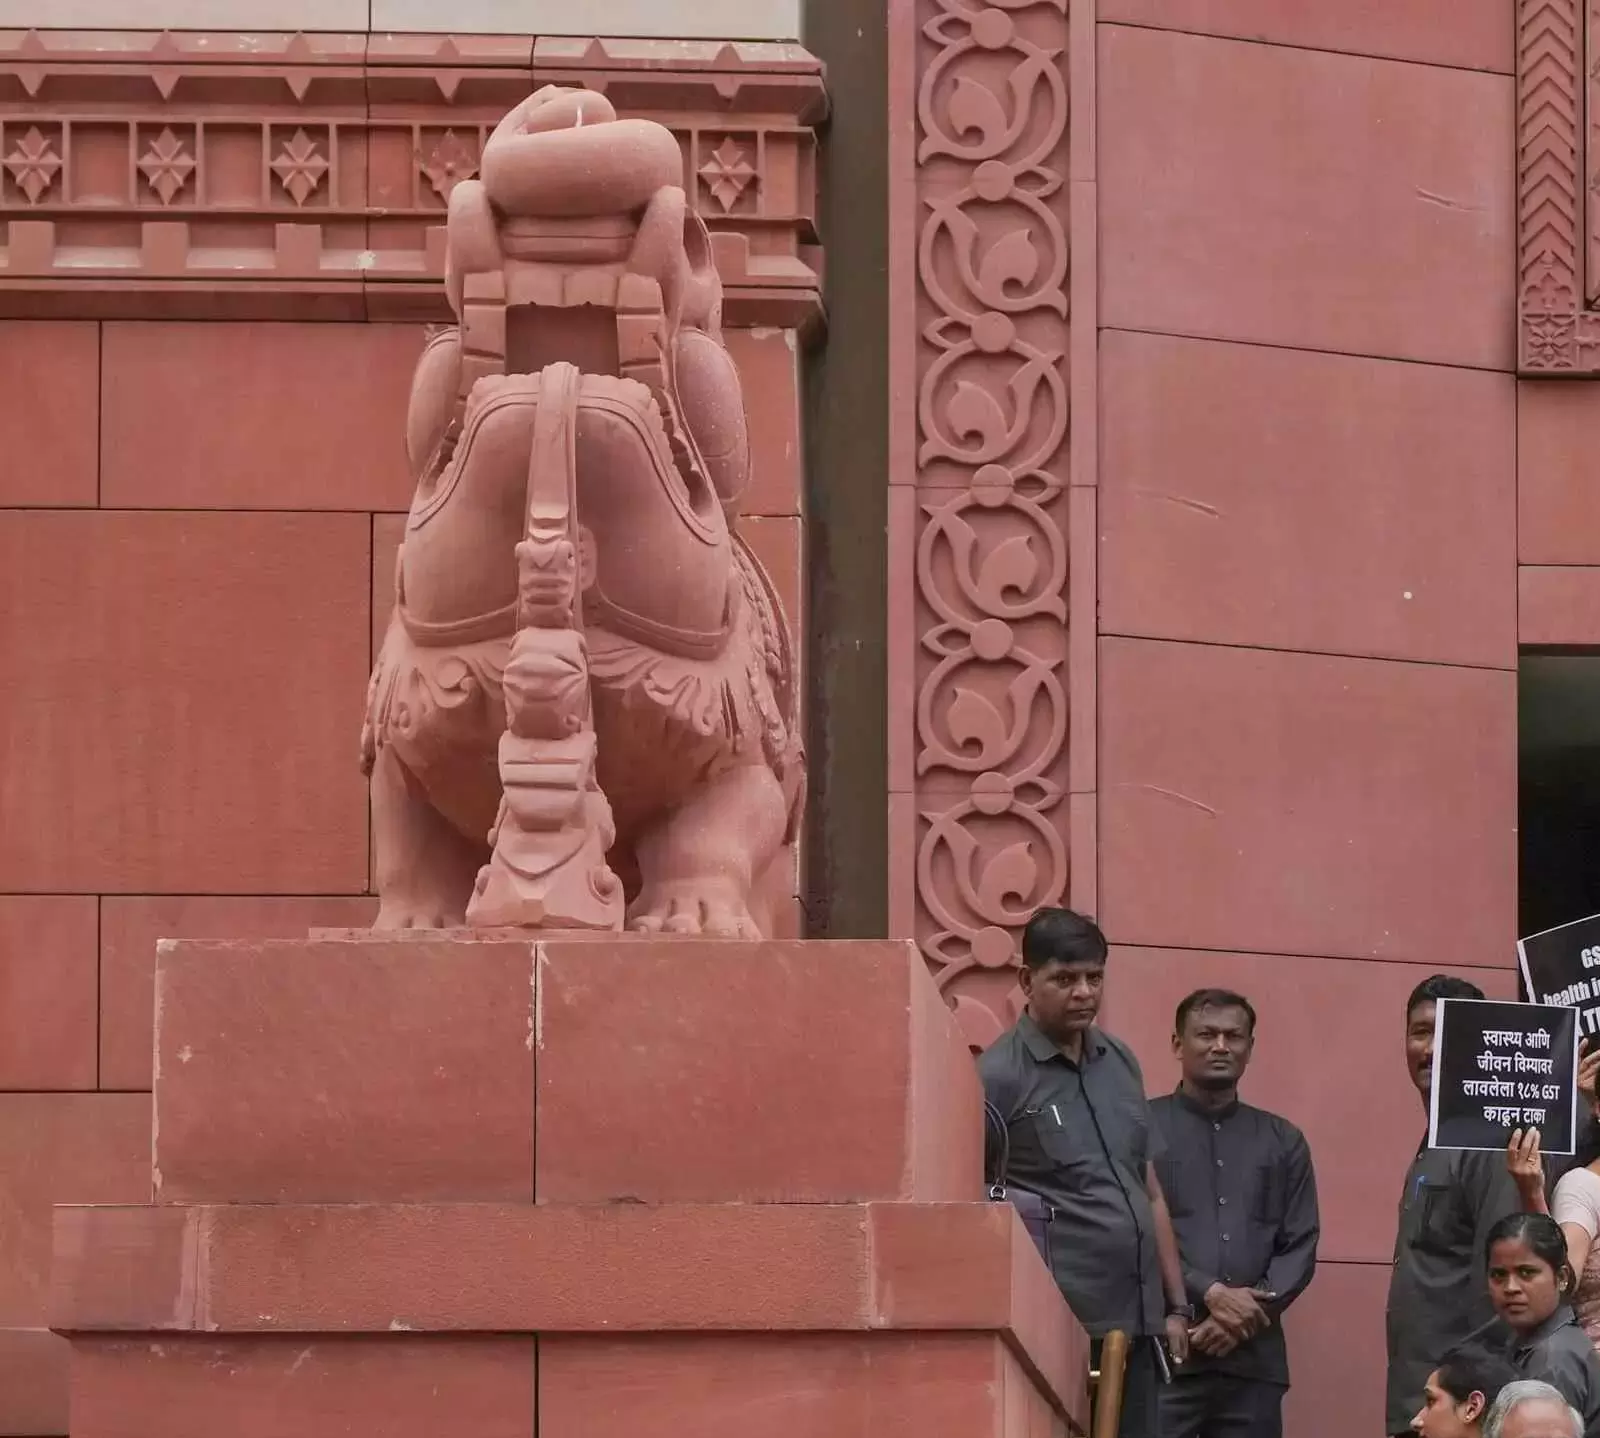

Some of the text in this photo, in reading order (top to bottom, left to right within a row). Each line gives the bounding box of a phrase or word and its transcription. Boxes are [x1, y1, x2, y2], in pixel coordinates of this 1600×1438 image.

[1481, 1027, 1551, 1049] स्वास्थ्य आणि
[1476, 1050, 1554, 1075] जीवन विम्यावर
[1462, 1075, 1561, 1101] लावलेला १८% GST
[1483, 1106, 1547, 1129] काढून टाका
